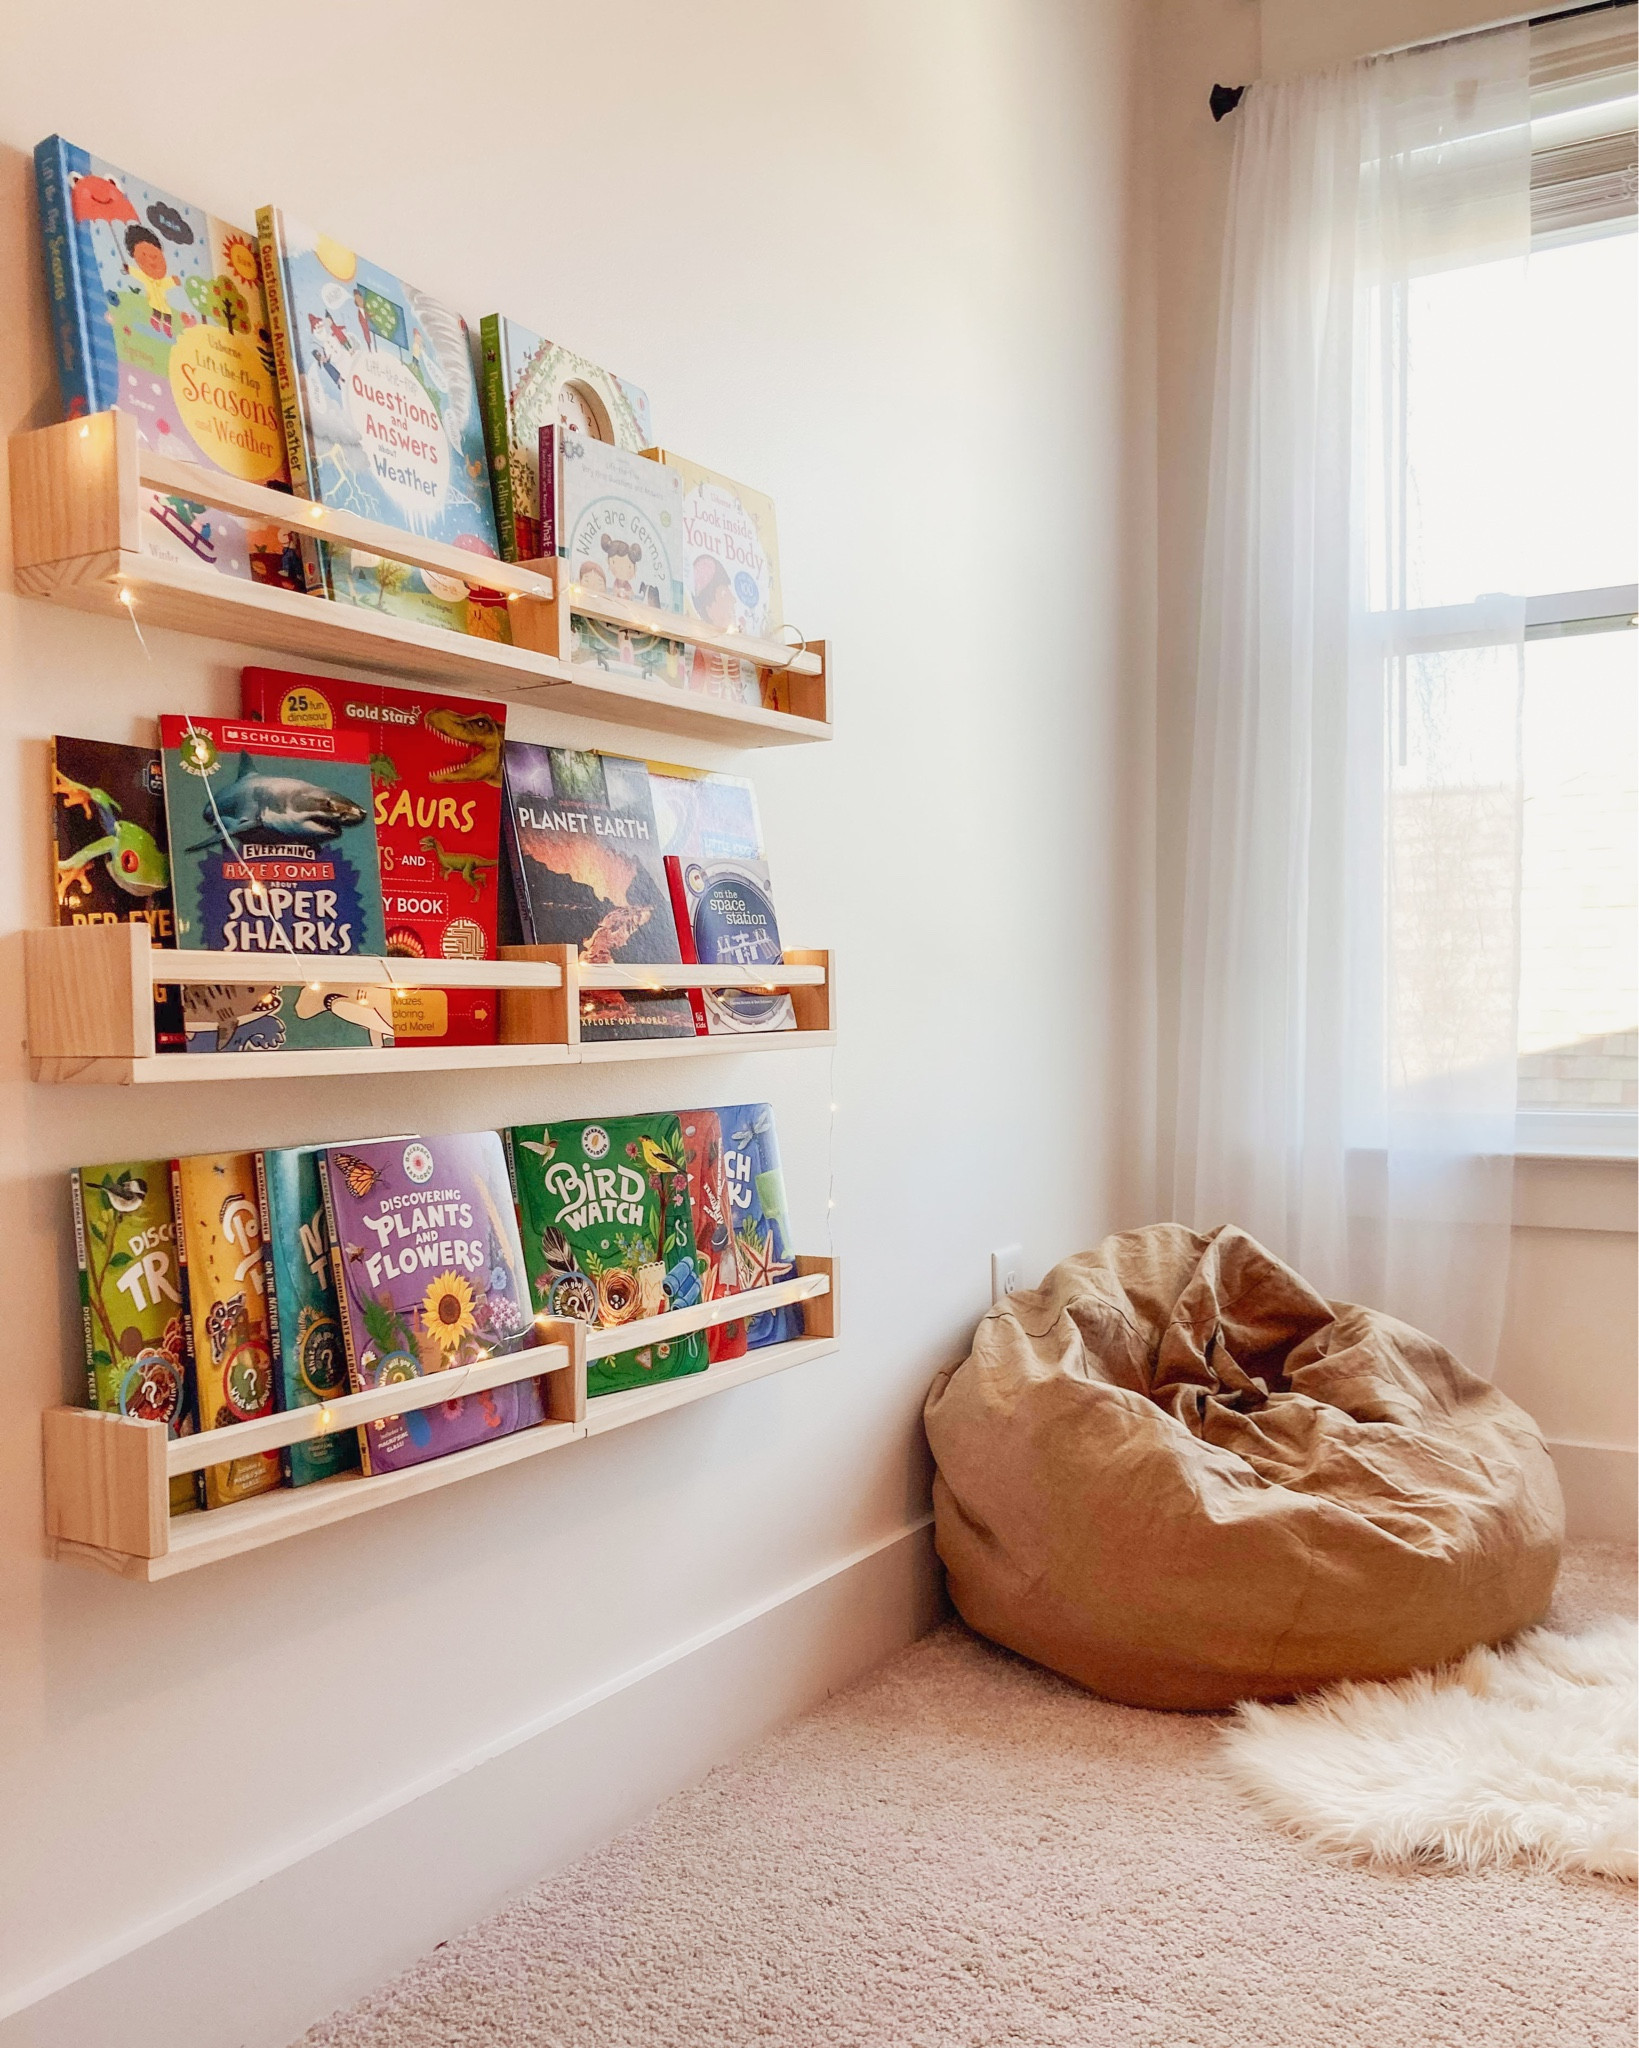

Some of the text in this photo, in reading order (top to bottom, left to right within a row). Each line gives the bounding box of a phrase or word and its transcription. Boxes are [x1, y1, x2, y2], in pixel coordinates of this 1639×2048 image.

[261, 245, 281, 315] Questions
[273, 332, 290, 391] Answers
[283, 404, 302, 472] Weather
[181, 363, 278, 432] Seasons
[352, 374, 439, 431] Questions
[391, 415, 408, 431] and
[213, 417, 274, 459] Weather
[366, 413, 438, 465] Answers
[373, 454, 438, 497] Weather
[542, 519, 553, 546] What
[694, 501, 753, 540] Look inside
[577, 510, 666, 581] What are Germs?
[683, 517, 763, 580] Your Body
[287, 695, 309, 712] 25
[287, 711, 328, 723] dinosaur
[346, 704, 417, 725] Gold Stars
[240, 731, 331, 748] SCHOLASTIC
[518, 807, 650, 841] PLANET EARTH
[245, 844, 315, 859] EVERYTHING
[401, 855, 426, 867] AND
[226, 864, 331, 879] AWESOME
[270, 881, 299, 889] ABOUT
[228, 887, 338, 920] SUPER
[397, 897, 443, 915] BOOK
[709, 899, 746, 914] space
[713, 890, 738, 899] on the
[726, 911, 767, 925] station
[223, 919, 352, 955] SHARKS
[618, 1017, 637, 1025] OUR
[639, 1016, 668, 1025] WORLD
[583, 1127, 607, 1142] BACKPACK
[405, 1146, 431, 1162] BACKPACK
[584, 1143, 608, 1155] EXPLORER
[406, 1165, 432, 1180] EXPLORER
[380, 1189, 461, 1213] DISCOVERING
[261, 1202, 269, 1235] EXPLORER
[363, 1203, 473, 1248] PLANTS
[564, 1199, 644, 1232] WATCH
[416, 1230, 439, 1245] AND
[365, 1239, 485, 1288] FLOWERS
[265, 1261, 281, 1359] ON THE NATURE TRAIL
[340, 1305, 351, 1336] PLANTS
[184, 1315, 194, 1358] BUG HUNT
[83, 1306, 97, 1401] DISCOVERING TREES
